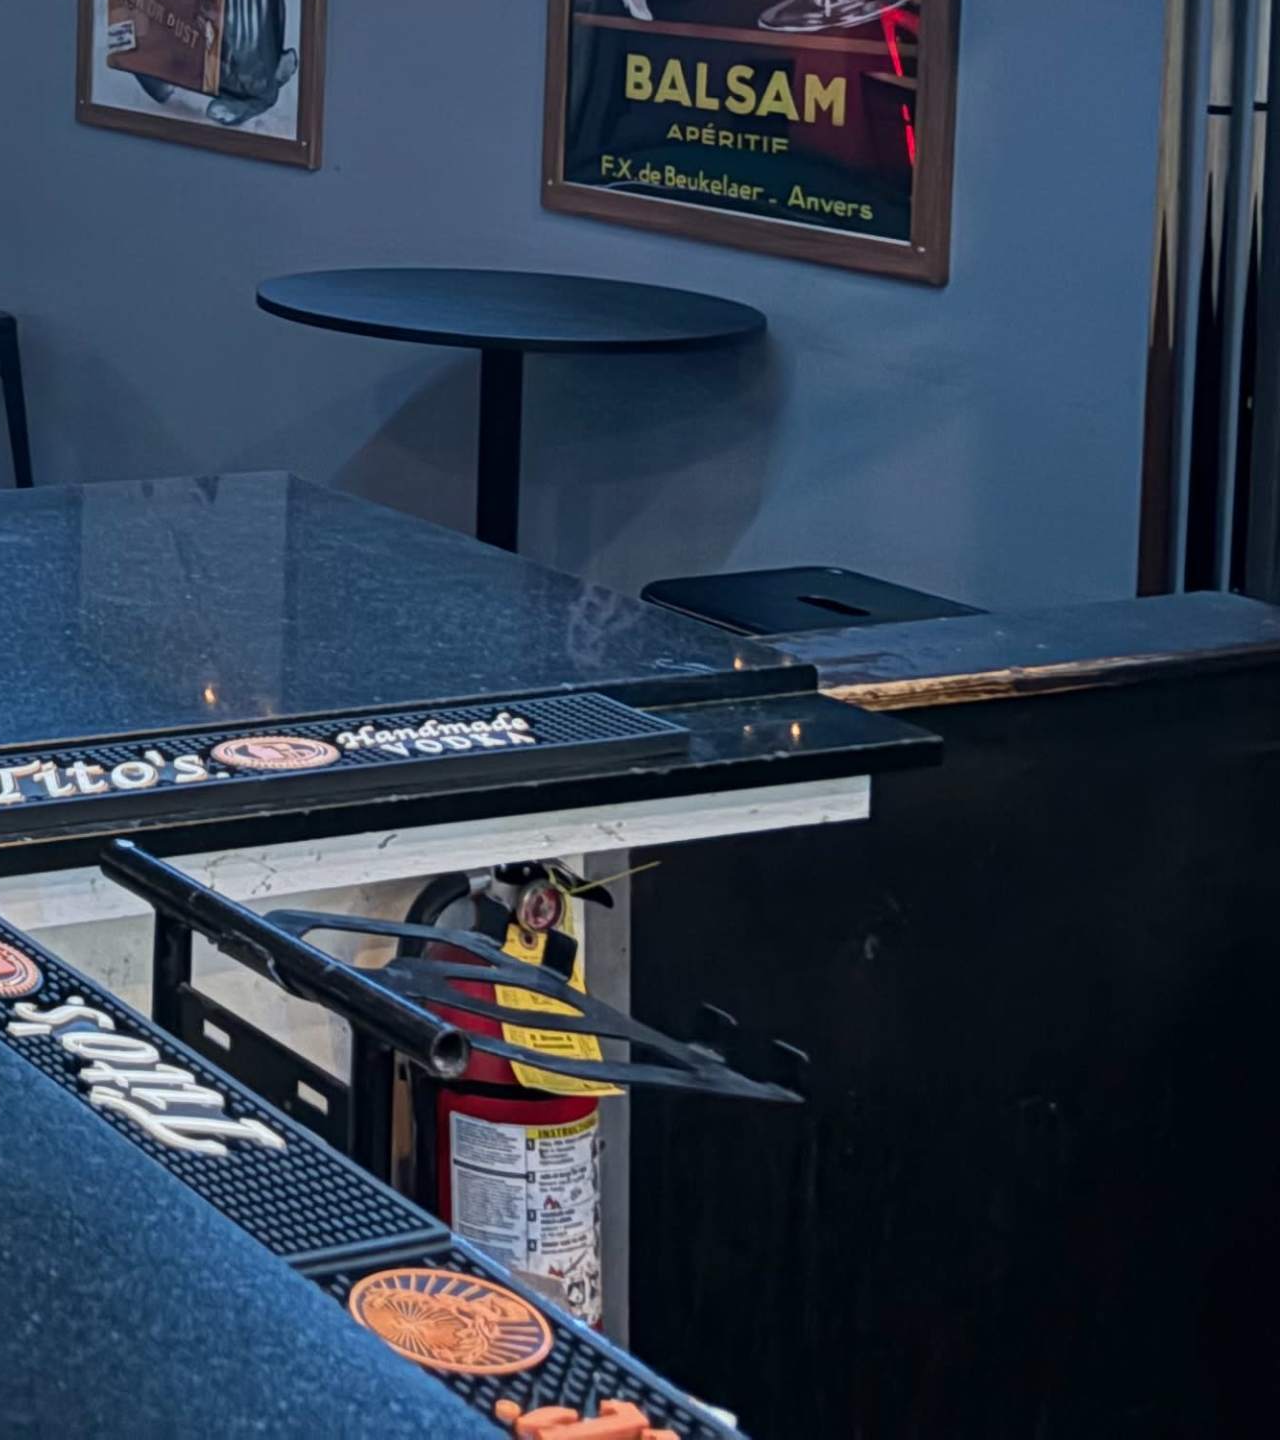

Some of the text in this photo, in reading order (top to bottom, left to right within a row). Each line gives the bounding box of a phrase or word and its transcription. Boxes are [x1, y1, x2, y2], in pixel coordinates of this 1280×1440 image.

[166, 11, 200, 49] DUST
[625, 53, 847, 127] BALSAM
[666, 122, 789, 154] APÉRITIF
[638, 162, 661, 185] de
[664, 165, 765, 201] Beukelaer
[787, 185, 874, 220] Anvers
[336, 711, 529, 750] Handmade
[380, 731, 536, 757] VODKA
